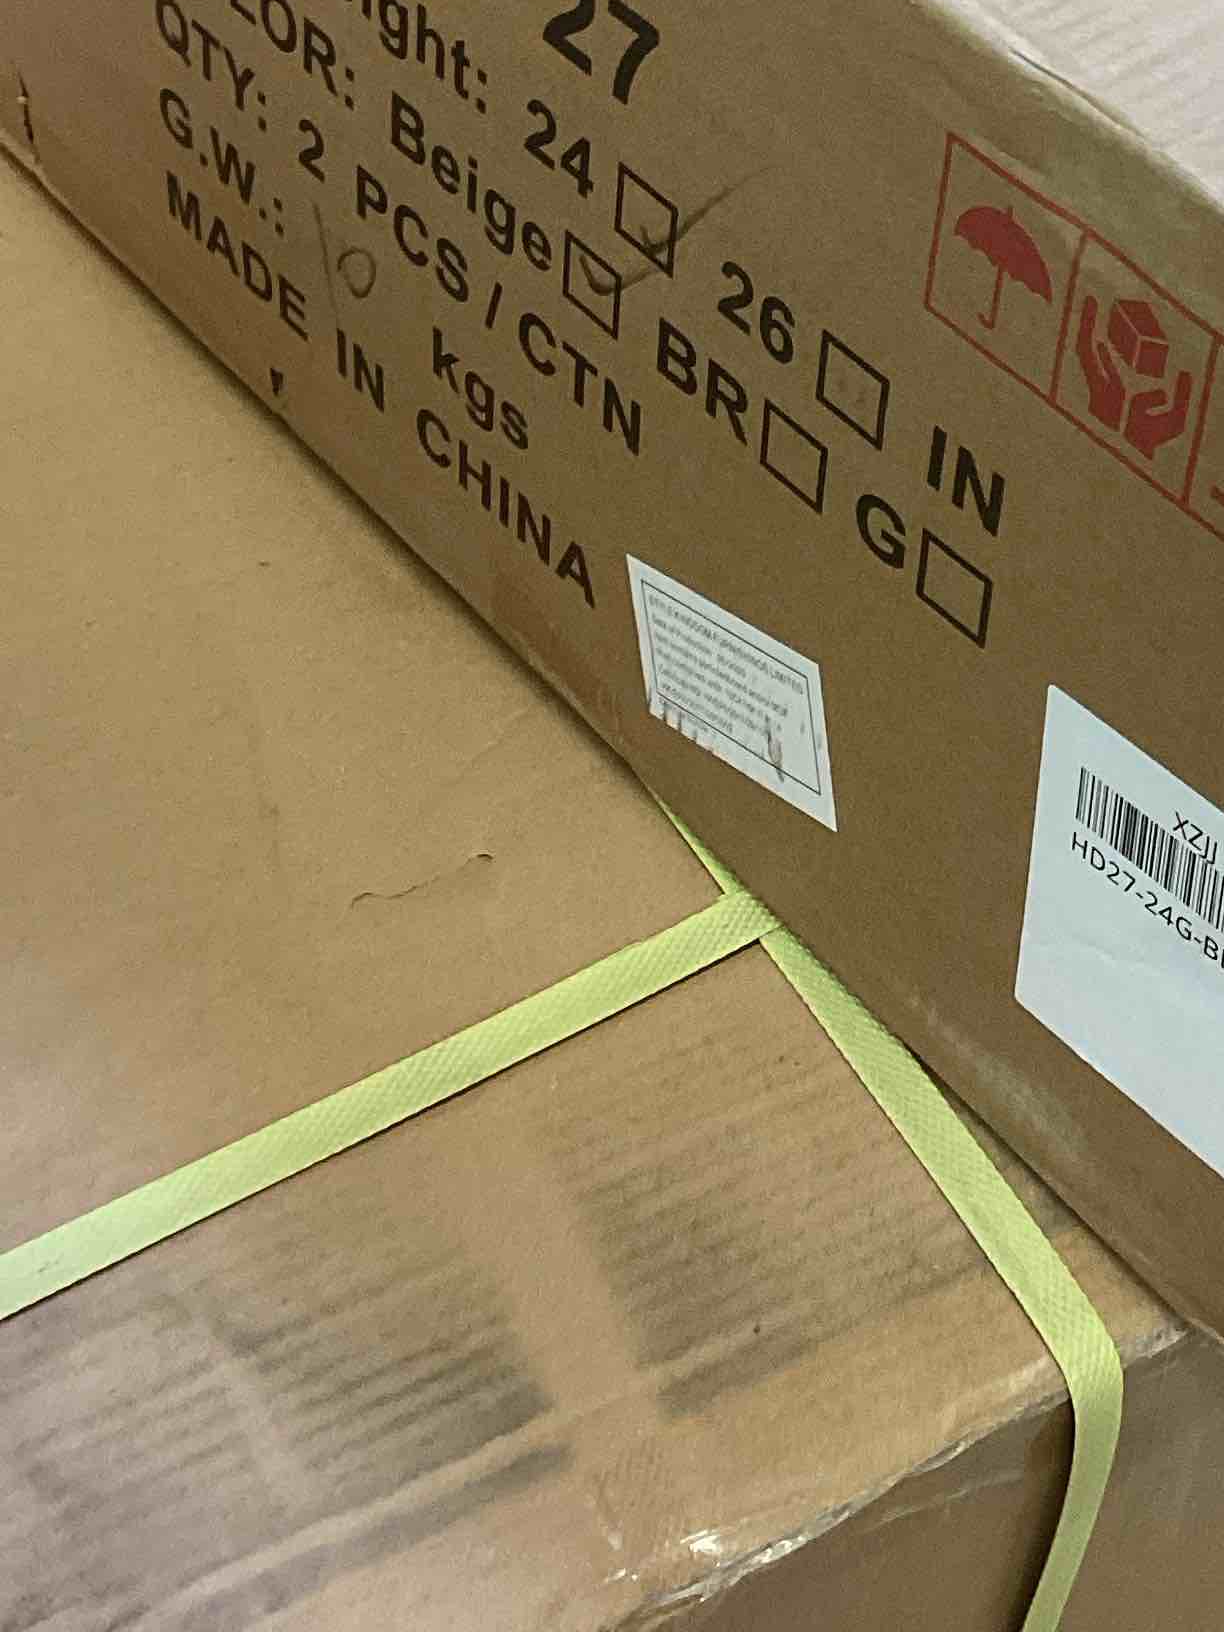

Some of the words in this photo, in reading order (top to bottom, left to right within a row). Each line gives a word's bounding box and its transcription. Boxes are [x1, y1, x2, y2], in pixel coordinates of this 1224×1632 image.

[298, 118, 326, 183] 2
[165, 170, 310, 342] MADE
[336, 327, 386, 414] IN
[416, 408, 596, 610] CHINA
[391, 90, 553, 272] Beige
[656, 317, 749, 447] BR
[855, 493, 907, 569] G
[432, 326, 529, 450] kgs
[523, 98, 594, 198] 24
[716, 260, 796, 365] 26
[926, 425, 1005, 537] IN
[1172, 811, 1218, 866] XZJJ
